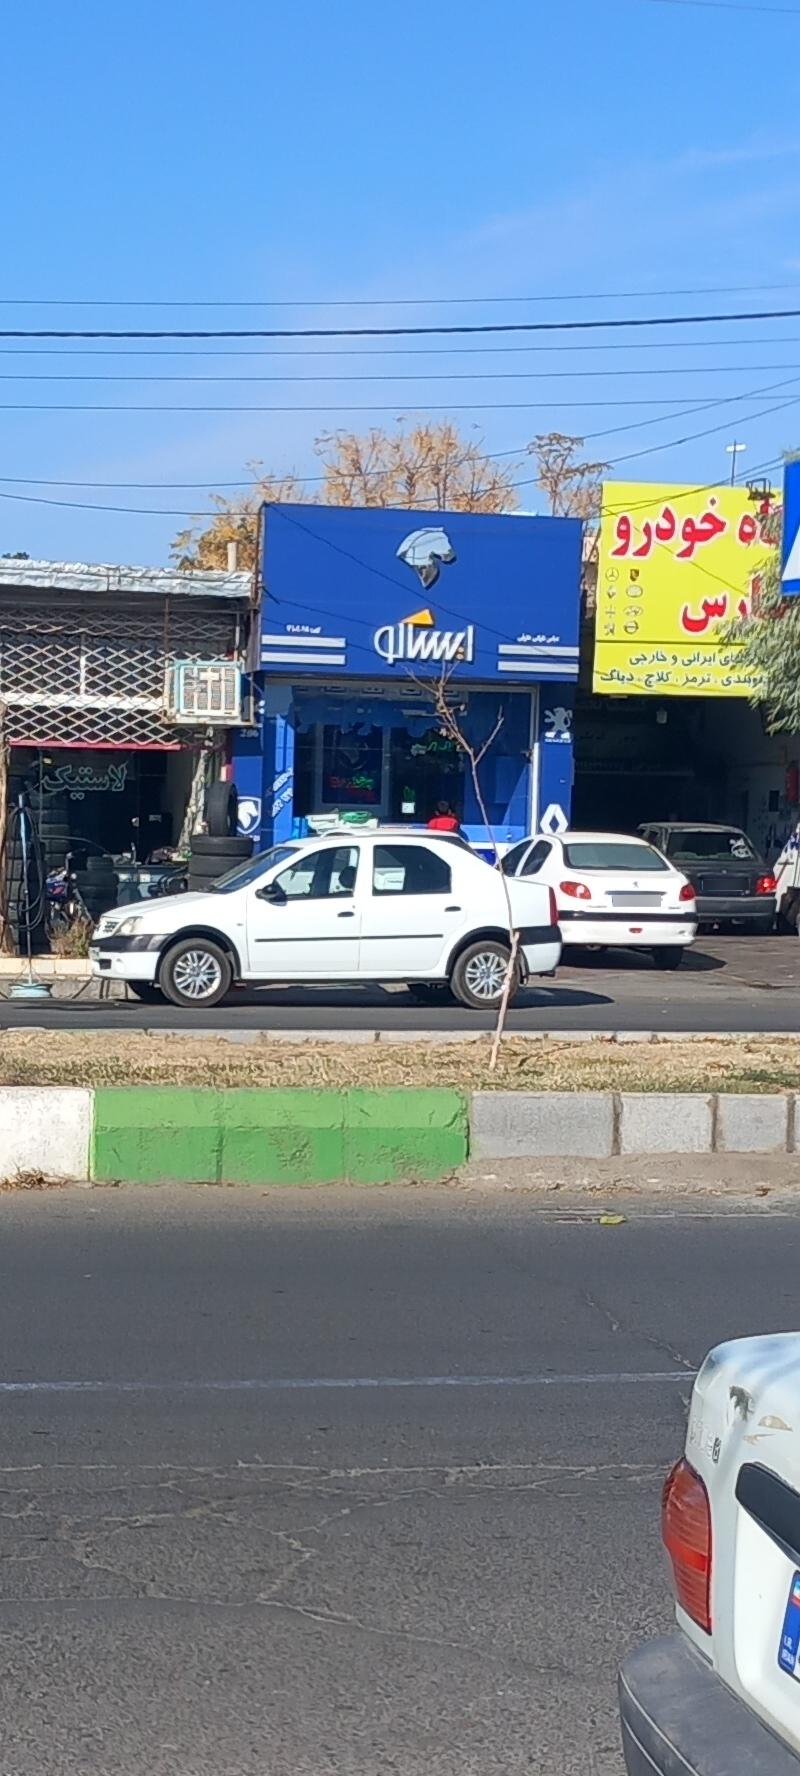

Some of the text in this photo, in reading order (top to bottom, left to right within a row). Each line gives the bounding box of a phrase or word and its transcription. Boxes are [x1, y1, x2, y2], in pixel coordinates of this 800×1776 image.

[611, 498, 727, 558] خودرو
[629, 650, 667, 666] خارجی
[671, 653, 678, 666] و
[682, 651, 716, 667] ایرانی
[600, 668, 766, 688] لوبندی ترمز کلاج دیاگ
[41, 760, 129, 801] لاستیک
